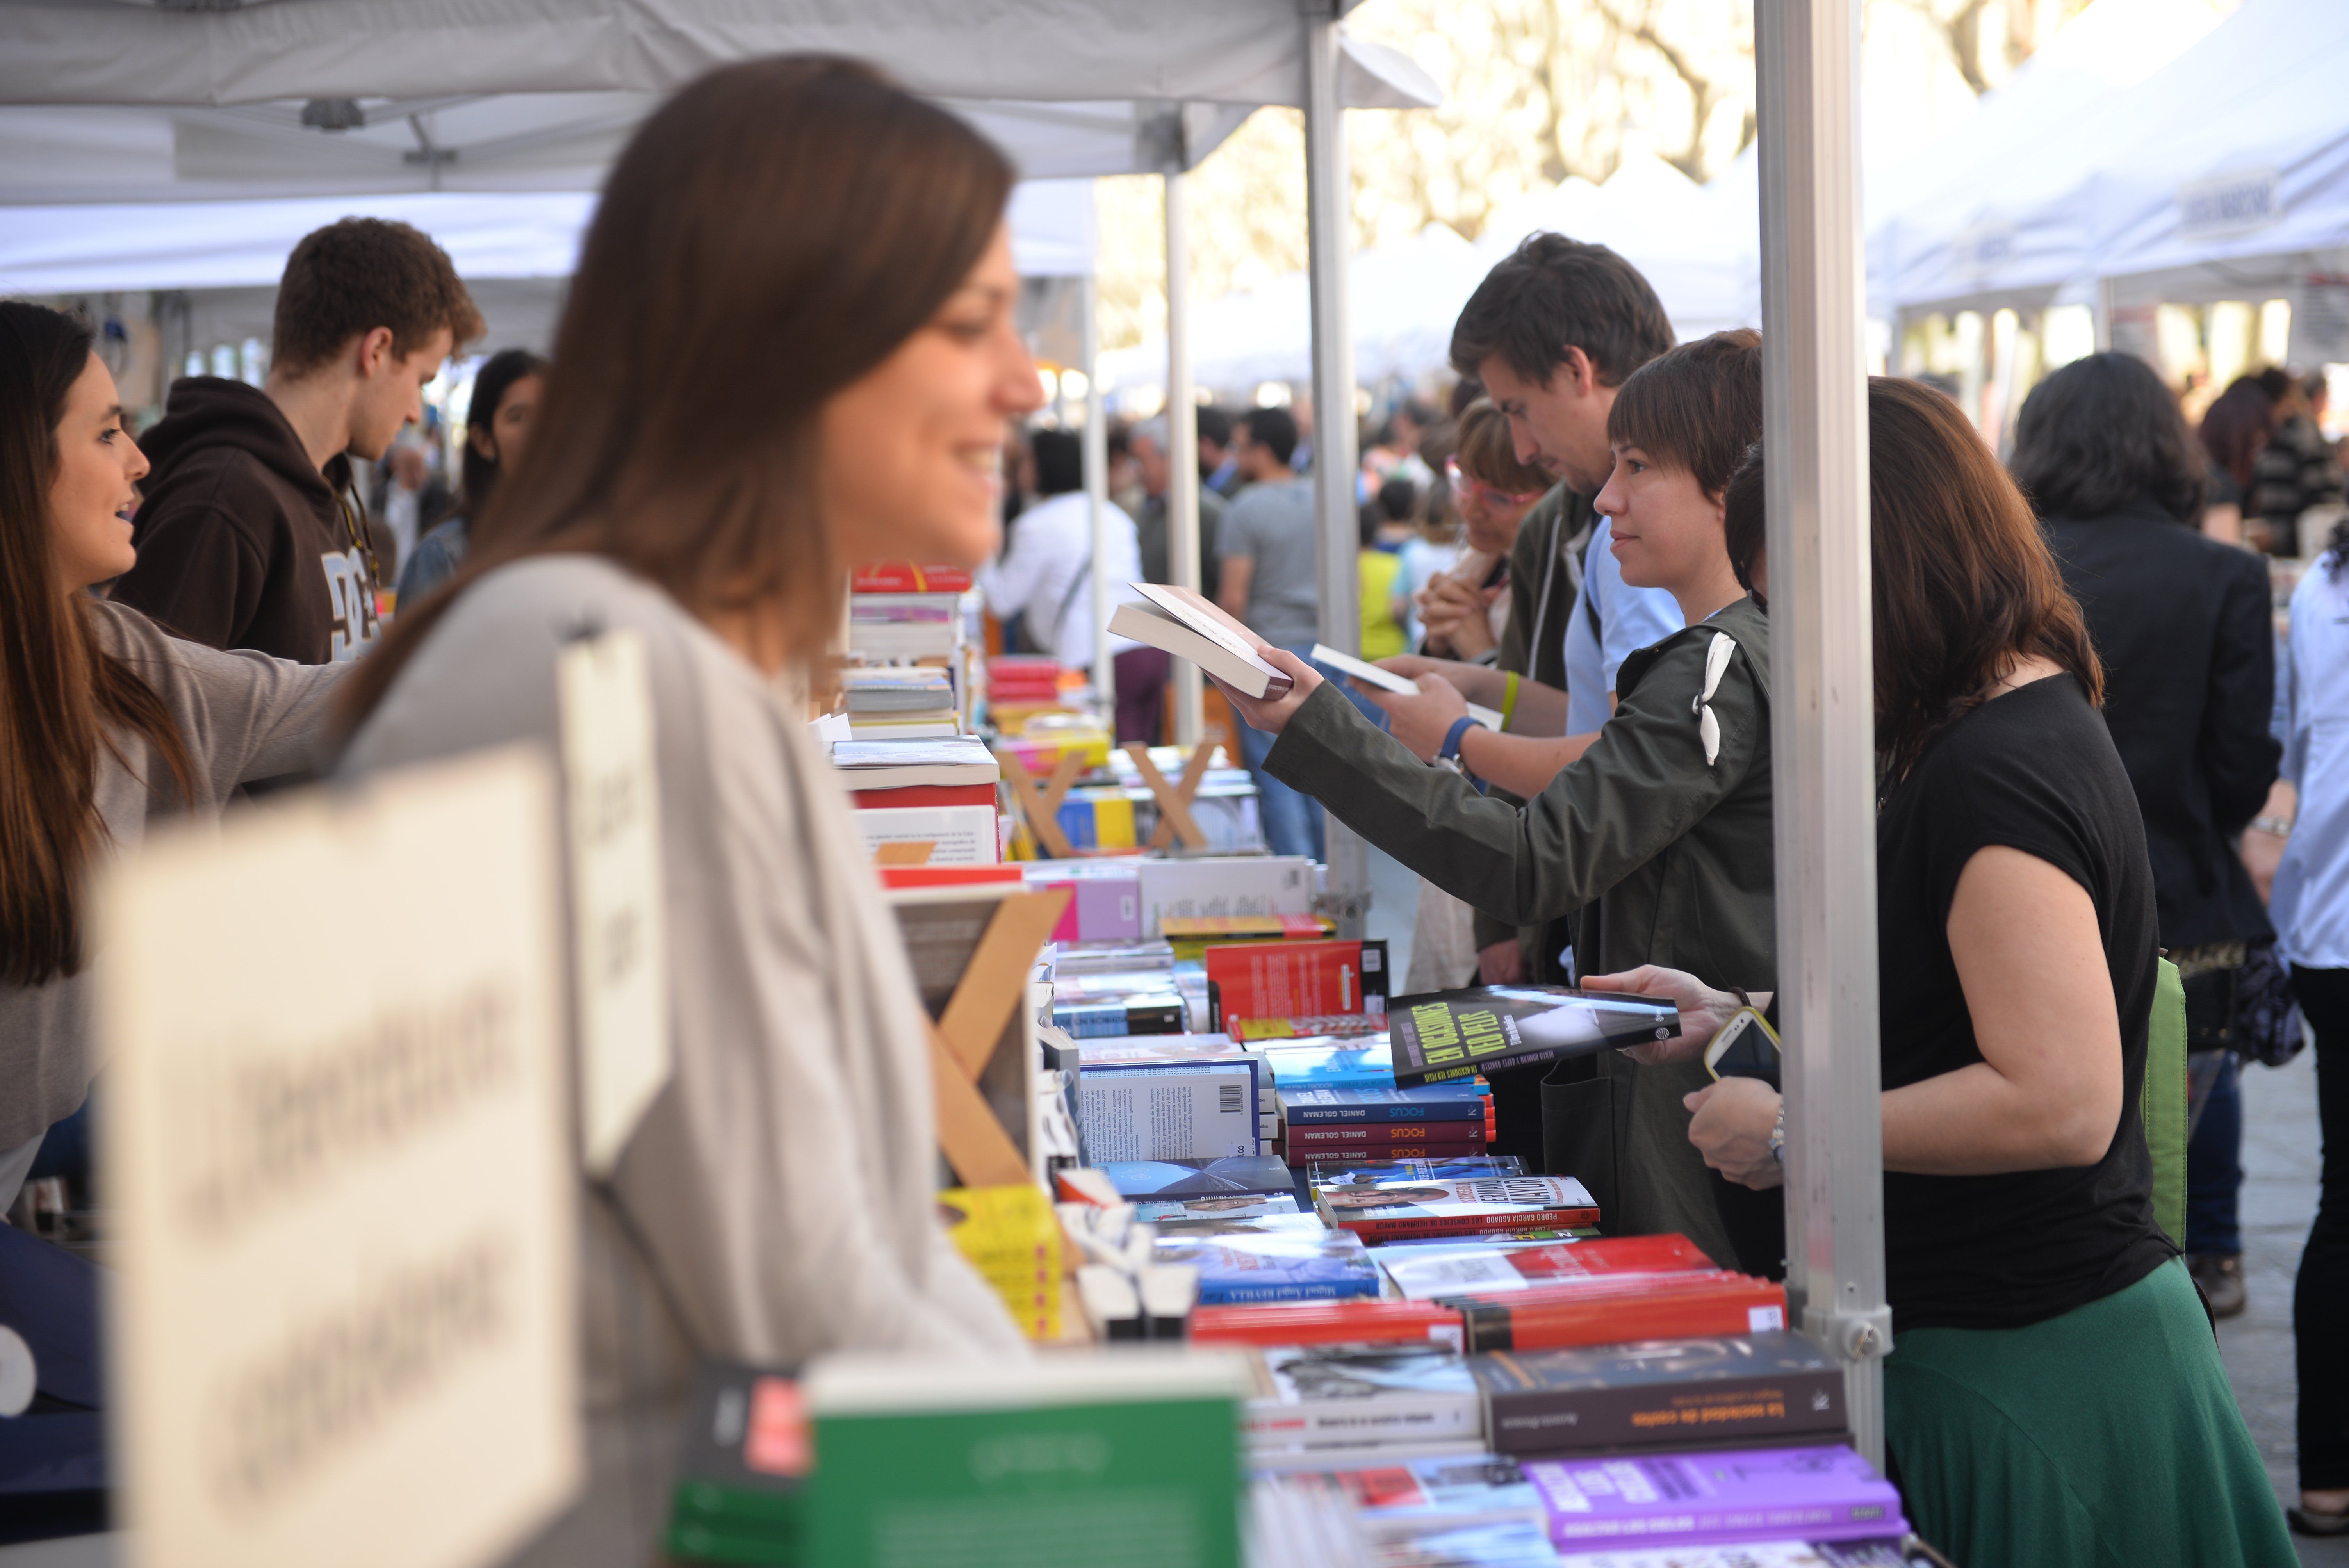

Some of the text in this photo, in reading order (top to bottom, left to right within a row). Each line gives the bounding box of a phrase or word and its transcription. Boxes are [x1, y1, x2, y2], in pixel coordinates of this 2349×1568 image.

[1411, 1002, 1460, 1049] OCASIONES
[1466, 1033, 1507, 1057] VEO
[1425, 1046, 1465, 1064] EN
[1447, 1066, 1471, 1078] OCASIONES
[1424, 1072, 1437, 1083] PELIS
[1390, 1107, 1424, 1117] FOCUS
[1391, 1128, 1425, 1138] FOCUS
[1391, 1149, 1425, 1158] FOCUS
[1503, 1179, 1551, 1204] MAYOR
[1439, 1218, 1469, 1226] CONSEJOS
[1486, 1215, 1510, 1224] AGUADO
[1512, 1214, 1535, 1223] GARCÍA
[1537, 1213, 1557, 1221] PEDRO
[1398, 1220, 1428, 1229] HERMANO
[1230, 1289, 1274, 1301] REVILLA
[1306, 1285, 1336, 1298] Miguel
